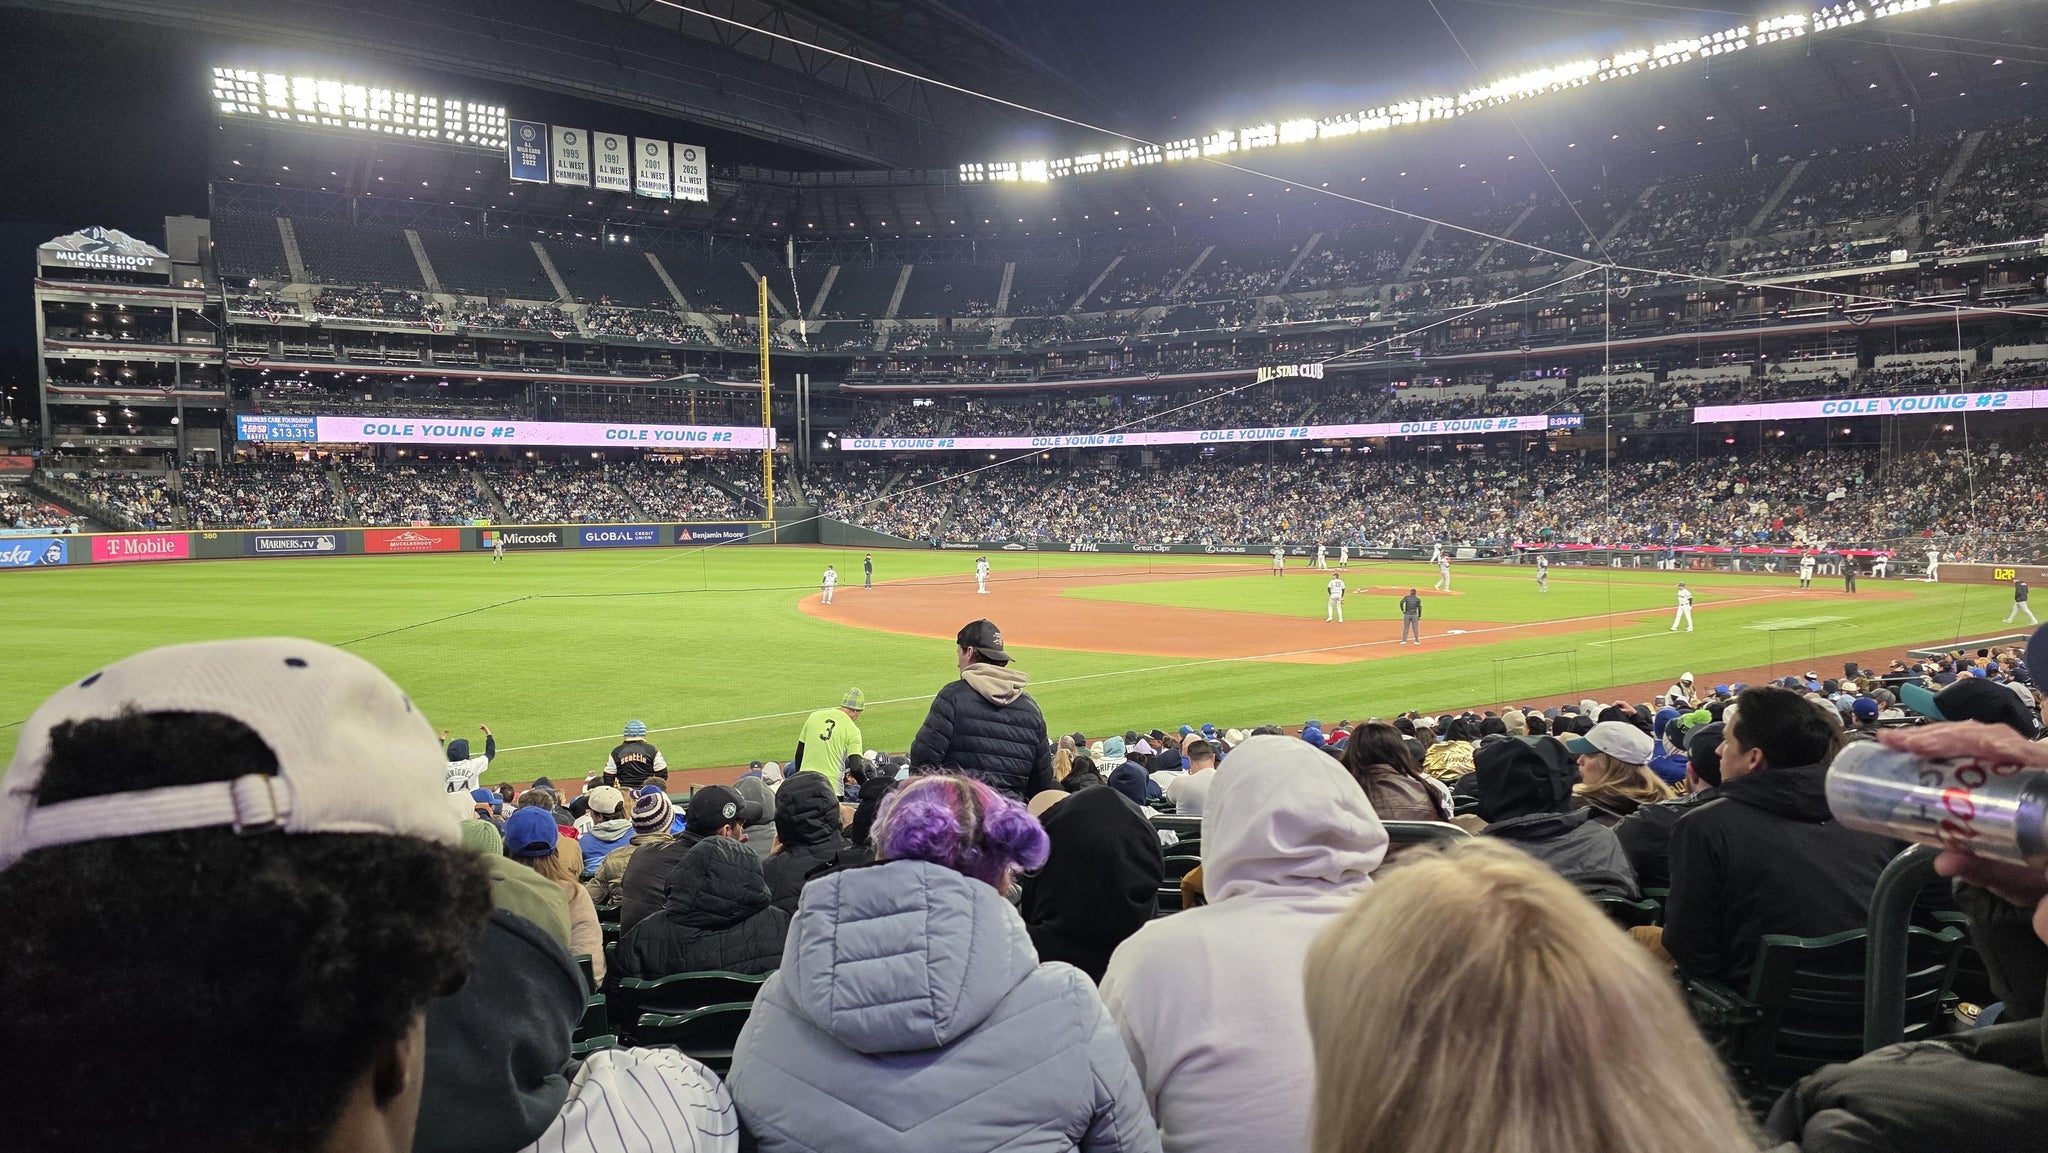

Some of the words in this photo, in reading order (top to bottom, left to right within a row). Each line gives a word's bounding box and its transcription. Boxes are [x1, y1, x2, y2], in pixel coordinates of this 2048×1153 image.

[563, 148, 579, 159] 1995
[604, 154, 619, 164] 1997
[558, 160, 568, 168] A.L.
[569, 162, 584, 170] WEST
[645, 159, 660, 169] 2001
[683, 165, 697, 174] 2025
[555, 170, 588, 181] CHAMPIONS
[600, 165, 609, 174] A.L.
[610, 166, 624, 175] WEST
[641, 170, 650, 179] A.L.
[651, 172, 664, 180] WEST
[597, 175, 628, 187] CHAMPIONS
[638, 180, 668, 191] CHAMPIONS
[689, 177, 702, 185] WEST
[677, 185, 705, 196] CHAMPIONS
[56, 251, 154, 266] MUCKLESHOOT
[75, 261, 107, 269] INDIAN
[1300, 363, 1324, 379] CLUB
[1822, 400, 1879, 415] COLE
[1888, 395, 1967, 411] YOUNG
[1975, 393, 2008, 408] #2
[363, 423, 414, 436] COLE
[422, 425, 486, 438] YOUNG
[491, 426, 515, 438] #2
[1400, 422, 1438, 434] COLE
[1443, 420, 1493, 431] YOUNG
[1497, 418, 1518, 429] #2
[272, 428, 315, 438] $13,315
[605, 429, 648, 440] COLE
[654, 430, 708, 442] YOUNG
[712, 432, 732, 442] #2
[1200, 431, 1235, 440] COLE
[1239, 429, 1285, 439] YOUNG
[1289, 428, 1308, 437] #2
[853, 440, 886, 448] COLE
[891, 440, 934, 448] YOUNG
[938, 440, 955, 448] #2
[1031, 437, 1061, 446] COLE
[1064, 436, 1104, 445] YOUNG
[1108, 435, 1124, 444] #2
[503, 532, 557, 544] Microsoft
[585, 532, 633, 541] GLOBAL
[692, 532, 722, 540] Benjamin
[124, 538, 174, 554] Mobile
[1069, 543, 1100, 551] STIHL
[1153, 544, 1171, 552] Clips
[0, 544, 32, 564] ska
[819, 719, 836, 741] 3
[621, 753, 647, 765] seattle
